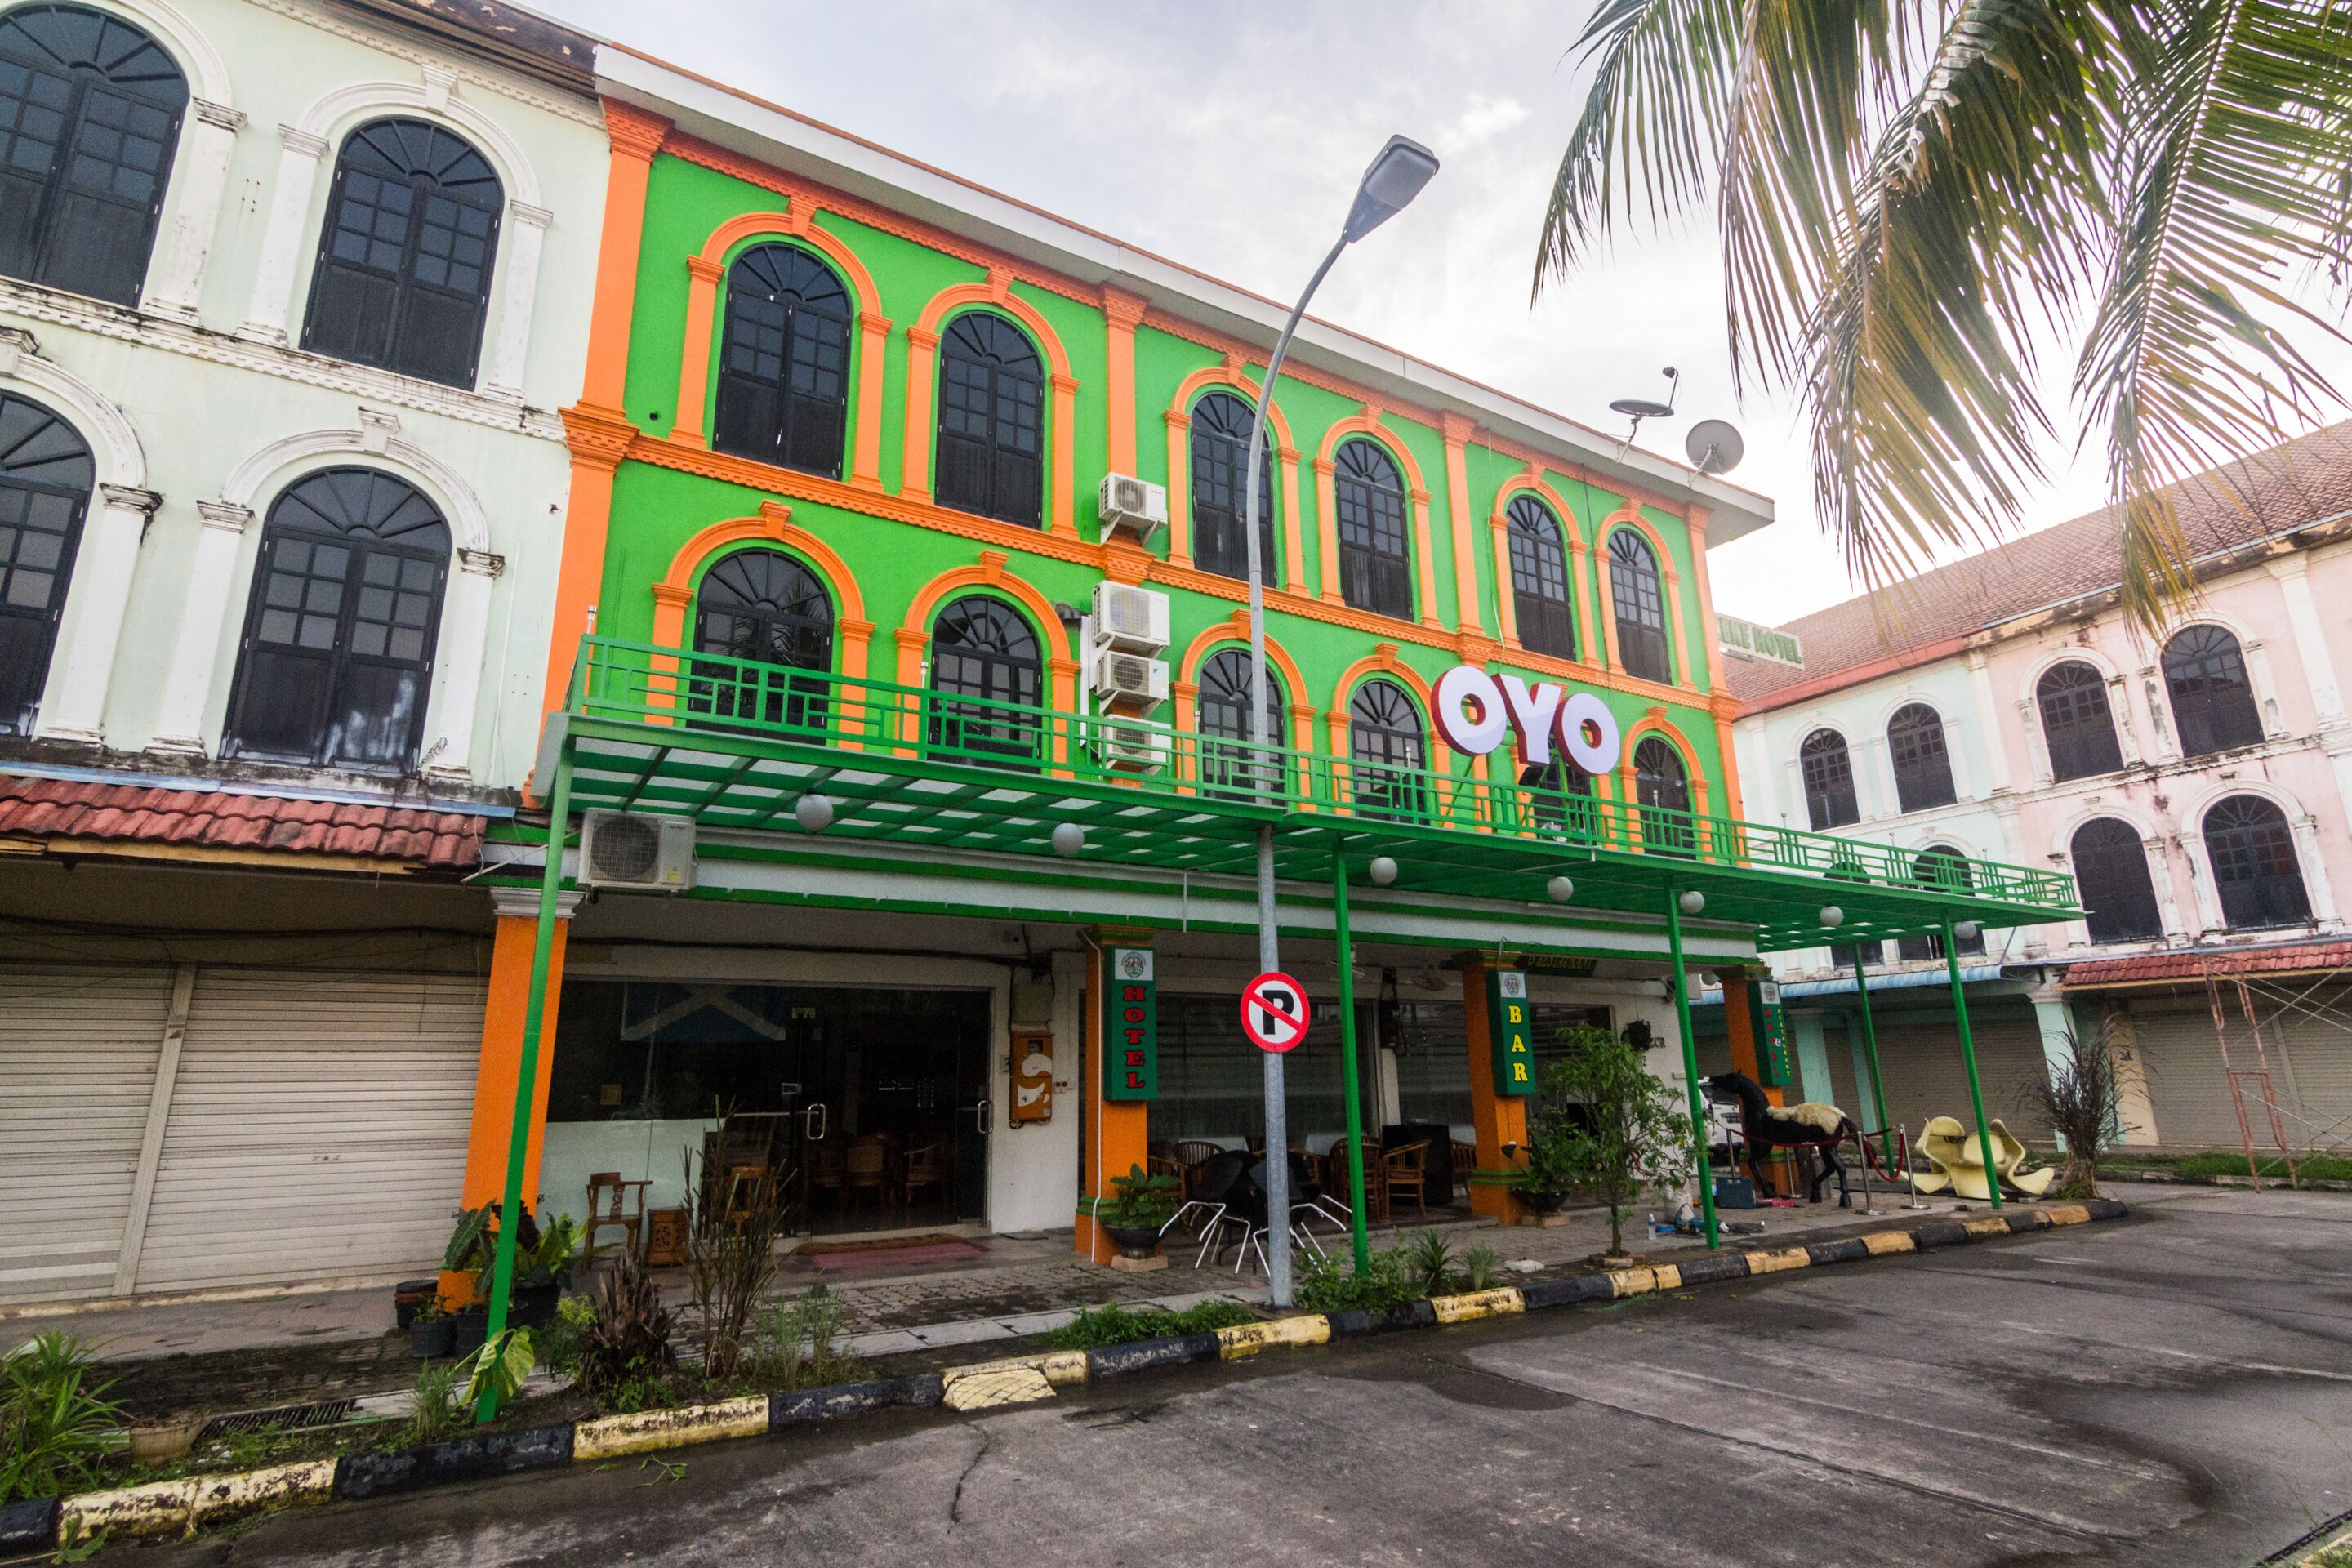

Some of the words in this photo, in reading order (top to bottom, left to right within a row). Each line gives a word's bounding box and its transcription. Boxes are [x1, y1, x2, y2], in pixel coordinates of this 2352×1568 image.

[1752, 626, 1802, 664] HOTEL
[1431, 665, 1620, 776] OYO
[1124, 986, 1146, 1089] HOTEL
[1262, 989, 1294, 1036] P
[1508, 1004, 1528, 1082] BAR
